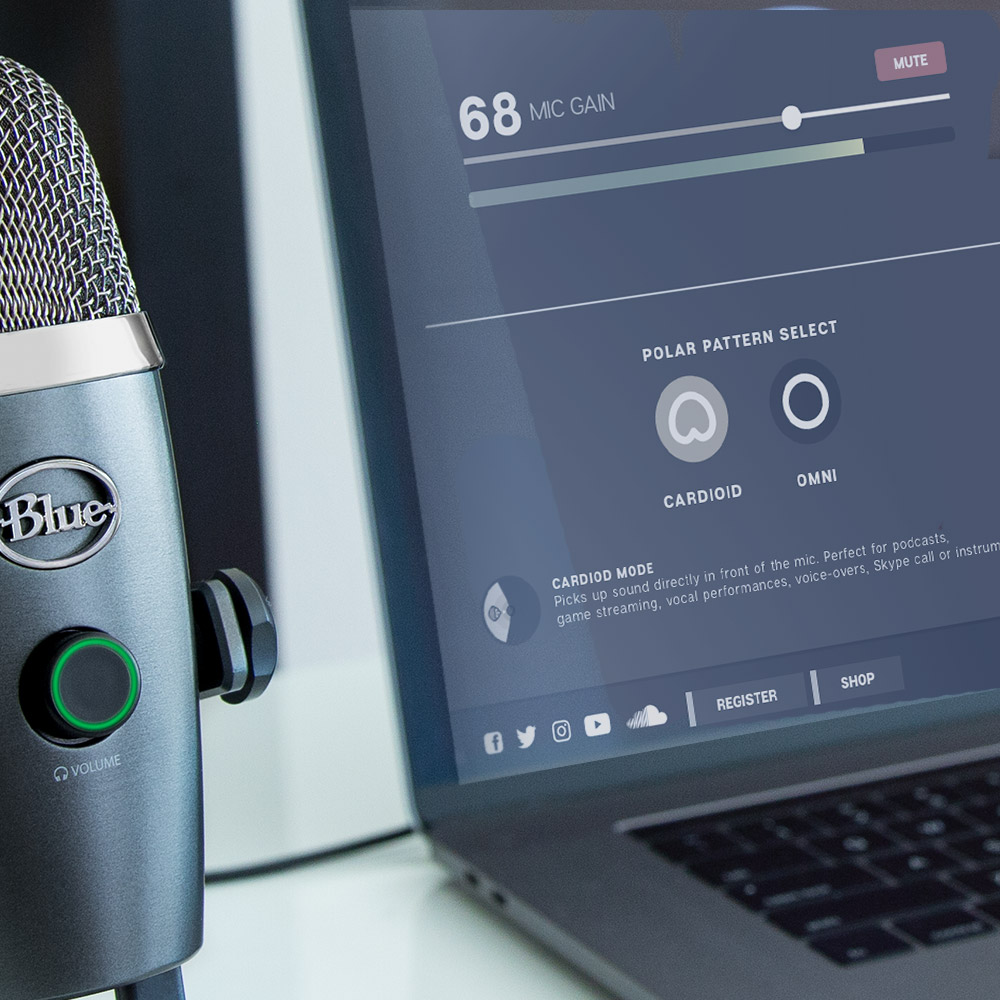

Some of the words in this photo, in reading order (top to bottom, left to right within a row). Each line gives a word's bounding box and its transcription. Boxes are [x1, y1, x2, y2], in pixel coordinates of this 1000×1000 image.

[893, 53, 929, 70] MUTE
[459, 91, 522, 141] 68
[529, 97, 565, 121] MIC
[570, 92, 616, 116] GAIN
[642, 341, 697, 362] POLAR
[702, 330, 774, 354] PATTERN
[779, 320, 838, 342] SELECT
[797, 468, 838, 488] OMNI
[663, 484, 743, 509] CARDIOID
[0, 492, 117, 542] Blue
[551, 569, 612, 590] CARDIOD
[616, 562, 655, 580] MODE
[554, 592, 588, 607] Picks
[592, 590, 608, 602] up
[612, 581, 650, 598] sound
[653, 573, 701, 591] directly
[704, 570, 716, 583] in
[720, 564, 750, 580] front
[754, 561, 766, 574] of
[771, 560, 790, 572] the
[794, 554, 819, 568] mic.
[823, 545, 867, 562] Perfect
[871, 542, 888, 554] for
[892, 532, 950, 552] podcasts,
[556, 609, 592, 628] game
[596, 598, 663, 618] streaming,
[666, 591, 699, 607] vocal
[702, 576, 792, 602] performances,
[794, 564, 870, 585] voice-overs,
[873, 556, 910, 573] Skype
[914, 550, 935, 565] call
[939, 550, 951, 561] or
[840, 671, 875, 690] SHOP
[716, 689, 778, 711] REGISTER
[70, 754, 122, 778] VOLUME
